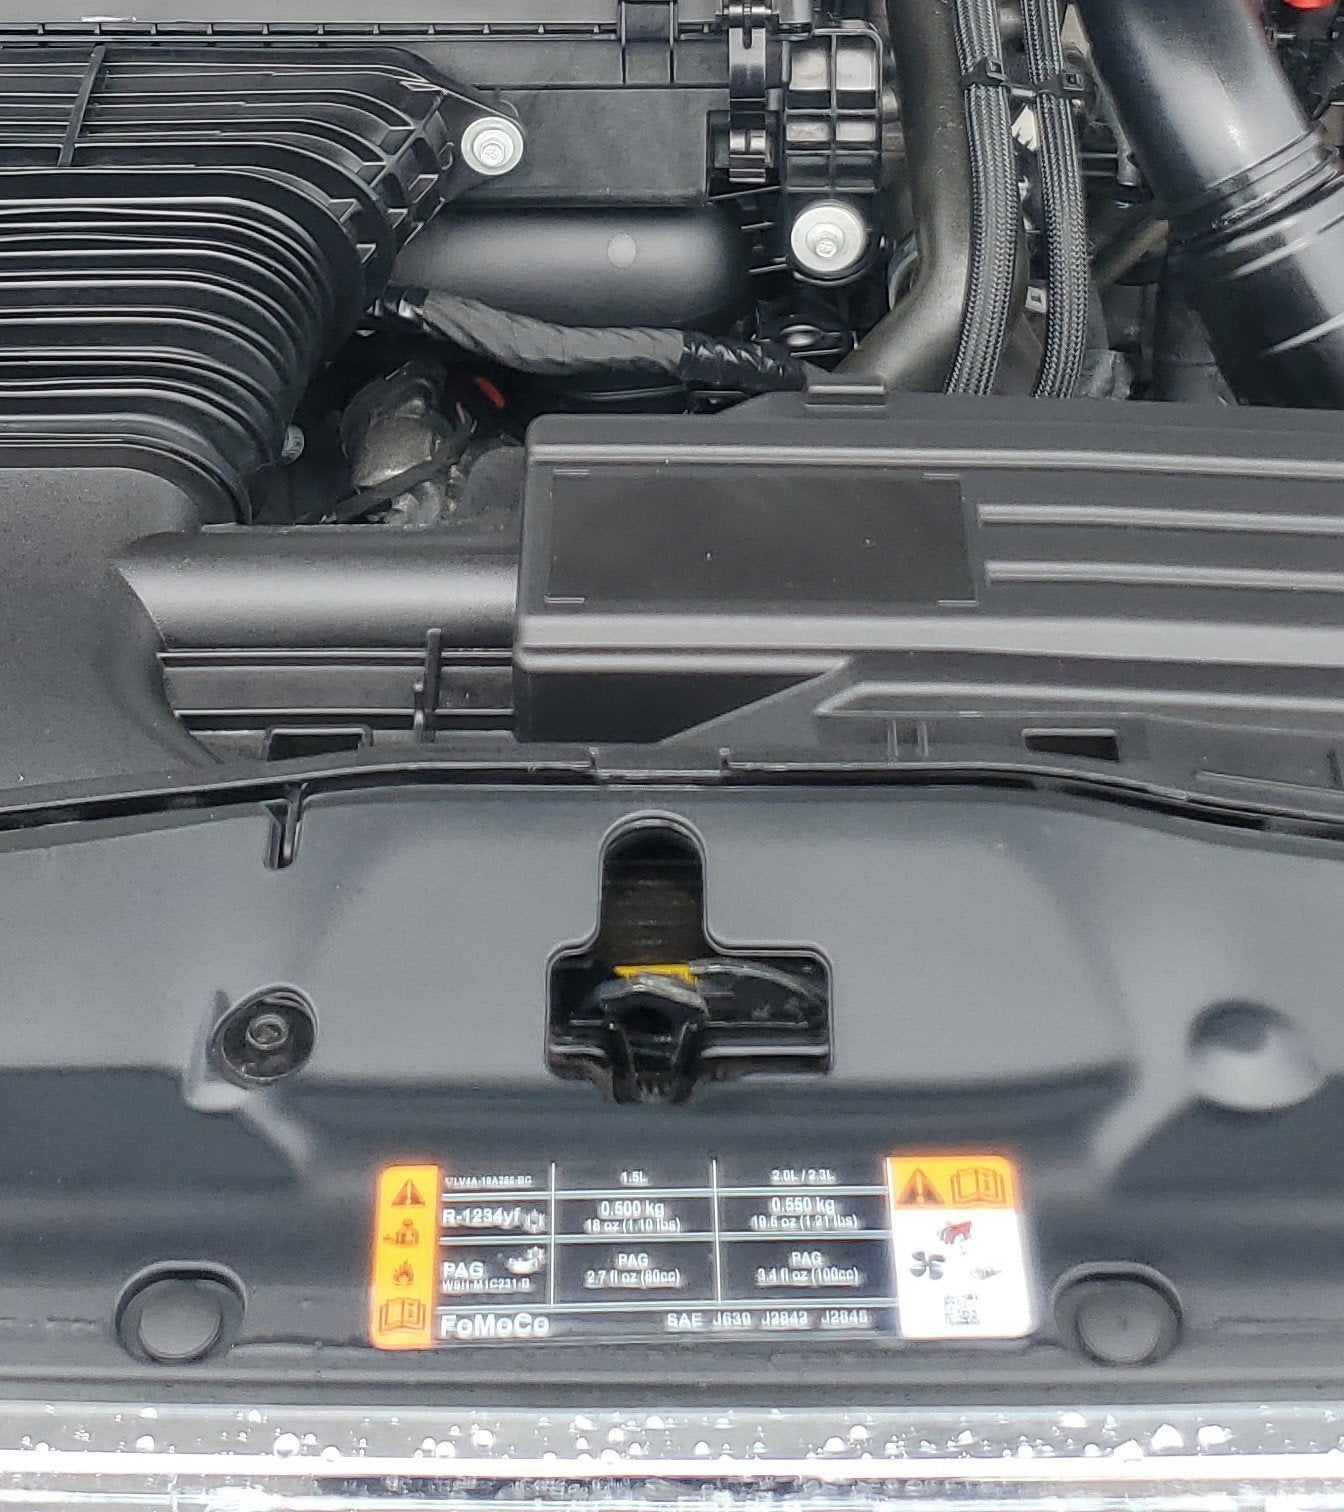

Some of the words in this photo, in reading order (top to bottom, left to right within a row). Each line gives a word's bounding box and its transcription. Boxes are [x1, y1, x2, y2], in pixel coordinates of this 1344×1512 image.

[600, 1200, 642, 1215] 0.500
[645, 1199, 665, 1217] kg
[771, 1197, 812, 1213] 0.550
[816, 1196, 835, 1215] kg
[442, 1207, 522, 1227] R-1234yf
[585, 1219, 601, 1232] 18
[603, 1221, 620, 1232] oz
[656, 1217, 681, 1233] lbs)
[781, 1218, 797, 1228] oz
[833, 1214, 858, 1229] lbs)
[617, 1253, 649, 1267] PAG
[790, 1251, 822, 1266] PAG
[442, 1262, 484, 1278] PAG
[792, 1272, 808, 1282] oz
[811, 1266, 859, 1285] (100cc)
[621, 1273, 638, 1284] oz
[440, 1313, 550, 1338] FoMoCo
[667, 1313, 703, 1327] SAE
